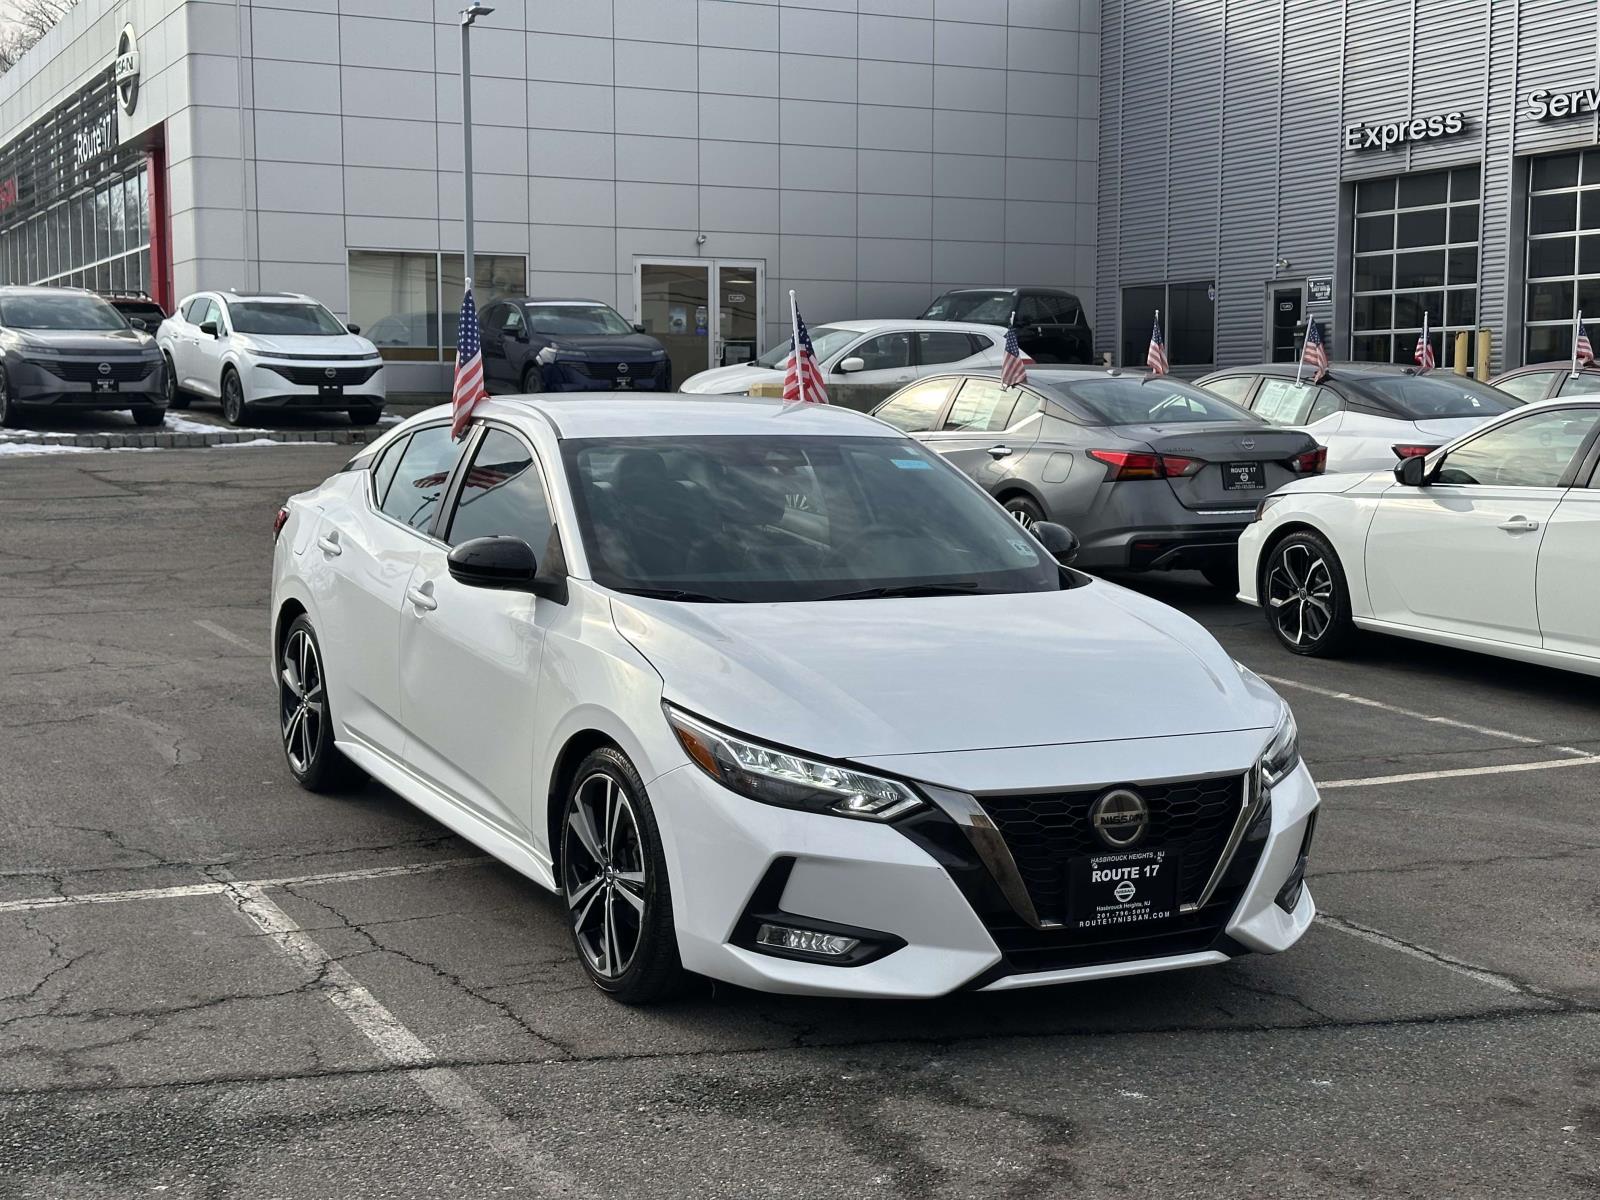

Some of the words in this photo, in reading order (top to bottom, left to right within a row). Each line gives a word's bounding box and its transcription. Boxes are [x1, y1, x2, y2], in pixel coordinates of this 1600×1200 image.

[77, 126, 102, 164] Route
[102, 113, 111, 152] 17
[1345, 111, 1464, 151] Express
[1101, 814, 1143, 825] NISSAN
[1092, 866, 1140, 882] ROUTE
[1144, 864, 1160, 877] 17
[1079, 911, 1170, 928] ROUTE17NISSAN.COM
